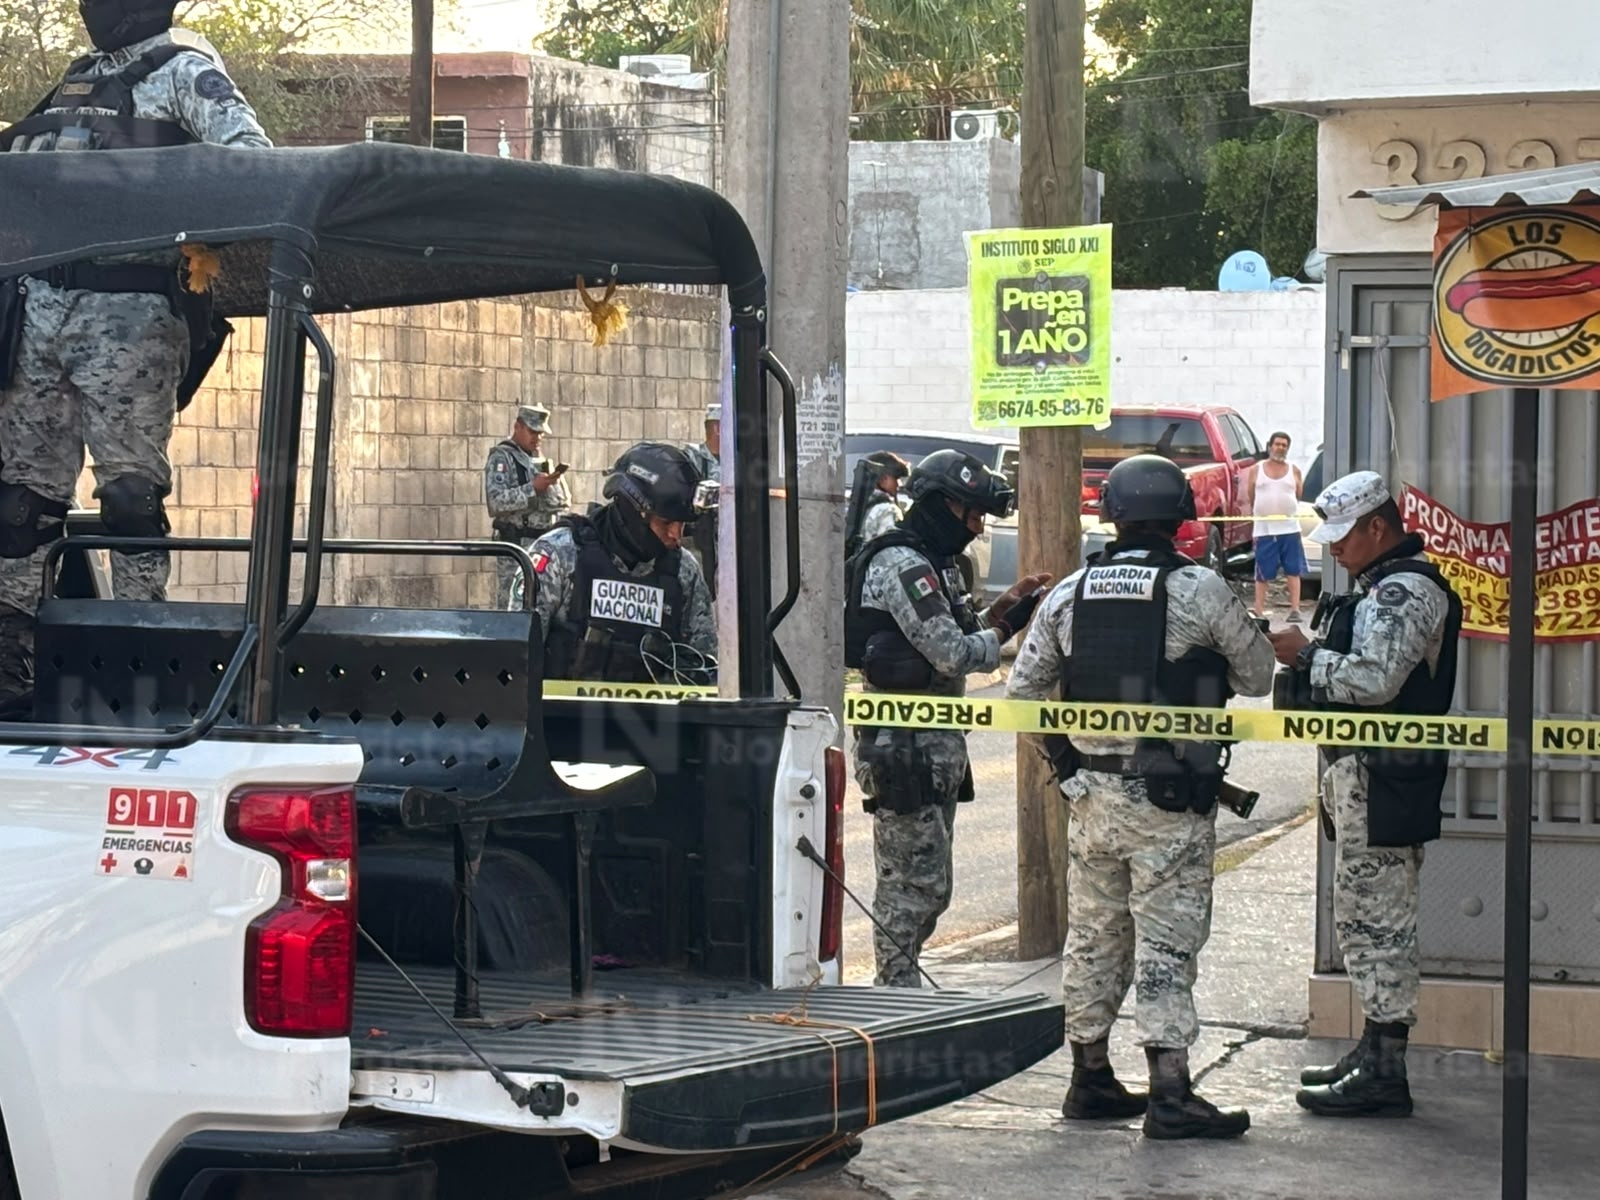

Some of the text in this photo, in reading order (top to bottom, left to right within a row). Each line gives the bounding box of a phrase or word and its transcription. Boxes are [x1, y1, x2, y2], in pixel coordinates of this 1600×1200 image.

[1507, 222, 1565, 246] LOS
[981, 237, 1099, 258] INSTITUTO SIGLO XXI
[1034, 258, 1055, 267] SEP
[1003, 287, 1084, 316] Prepa
[1056, 310, 1086, 325] en
[998, 321, 1088, 355] 1 AÑO
[1464, 329, 1600, 375] DOGADICTOS
[998, 397, 1104, 418] 6674-95-83-76
[1404, 491, 1600, 553] PROXIMAENTE
[1536, 541, 1600, 572] ENTA
[1089, 568, 1152, 580] GUARDIA
[1491, 579, 1499, 594] Y
[597, 582, 659, 607] GUARDIA
[1089, 581, 1145, 595] NACIONAL
[593, 599, 660, 625] NACIONAL
[845, 699, 993, 727] PRECAUCI
[1040, 706, 1233, 736] PRECAUCIÓN
[1284, 716, 1489, 747] PRECAUCIÓN
[1542, 727, 1600, 750] IÓN
[114, 793, 188, 823] 911
[102, 836, 193, 854] EMERGENCIAS
